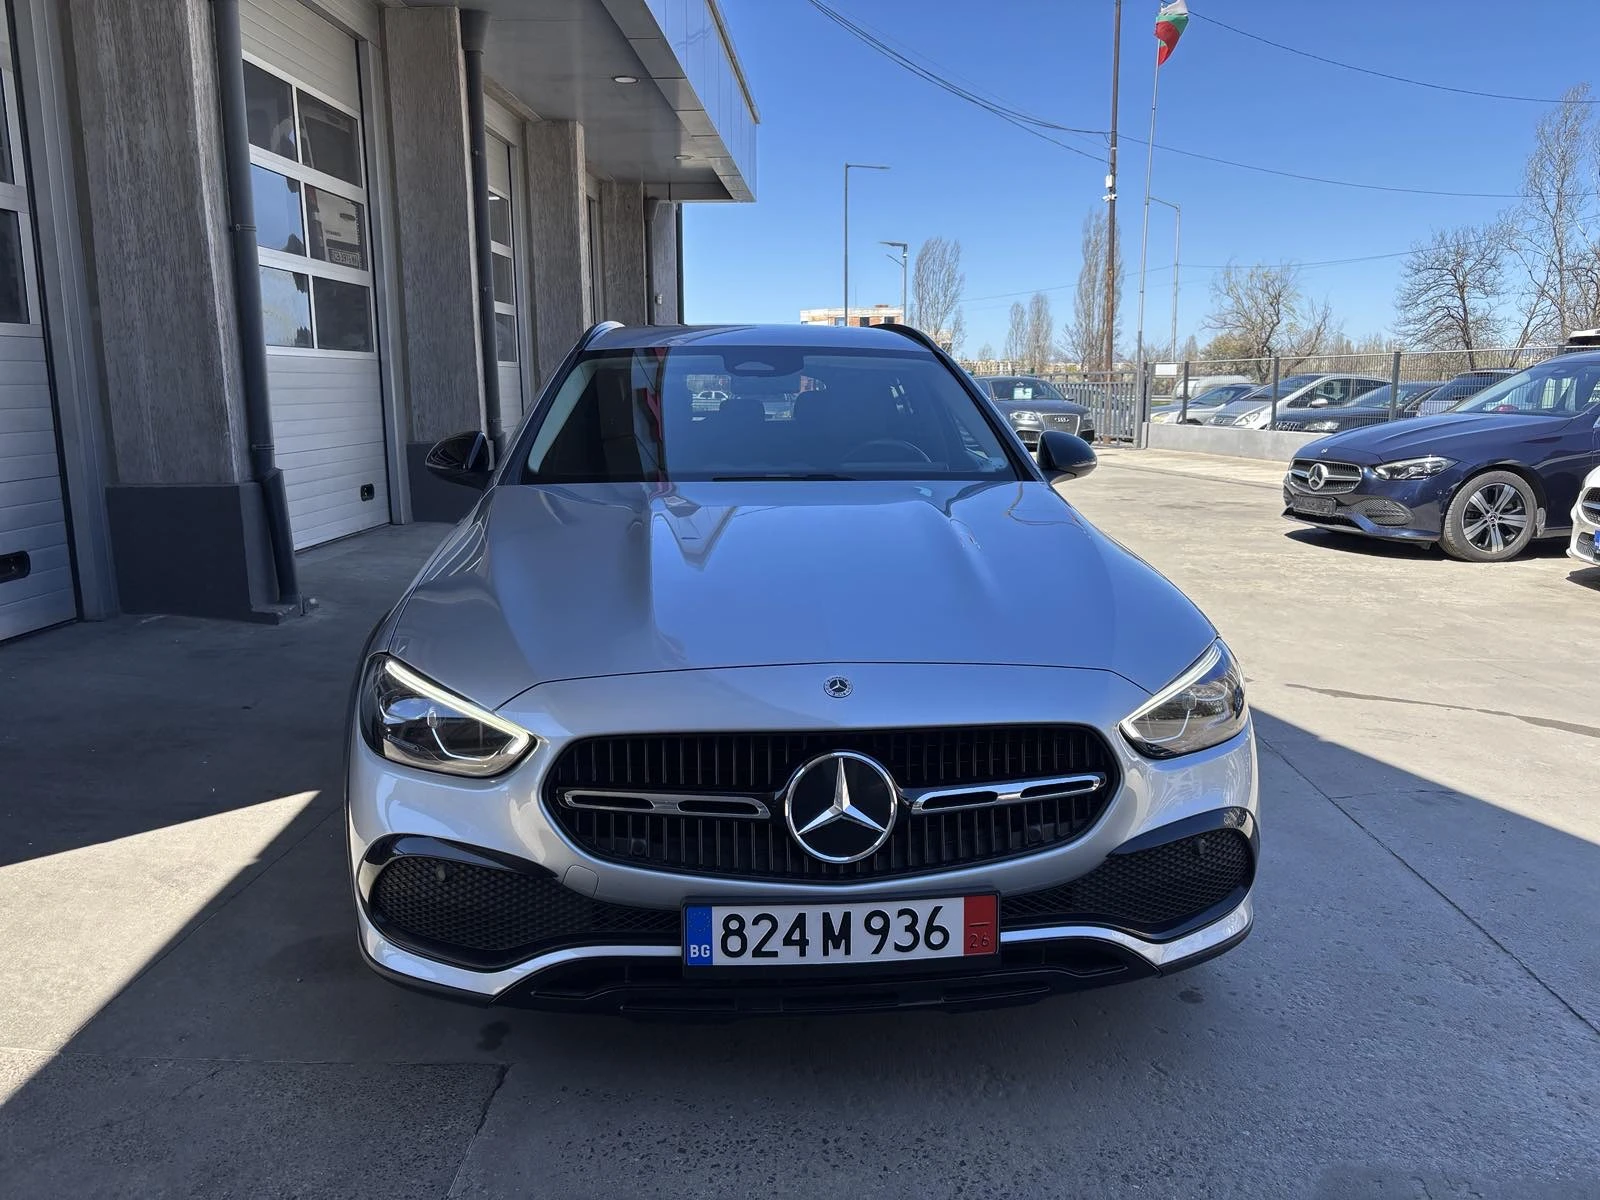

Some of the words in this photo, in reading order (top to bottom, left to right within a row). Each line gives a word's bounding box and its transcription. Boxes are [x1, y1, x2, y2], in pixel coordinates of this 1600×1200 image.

[720, 911, 809, 958] 824
[822, 911, 852, 957] M
[864, 905, 951, 955] 936
[690, 944, 710, 958] BG
